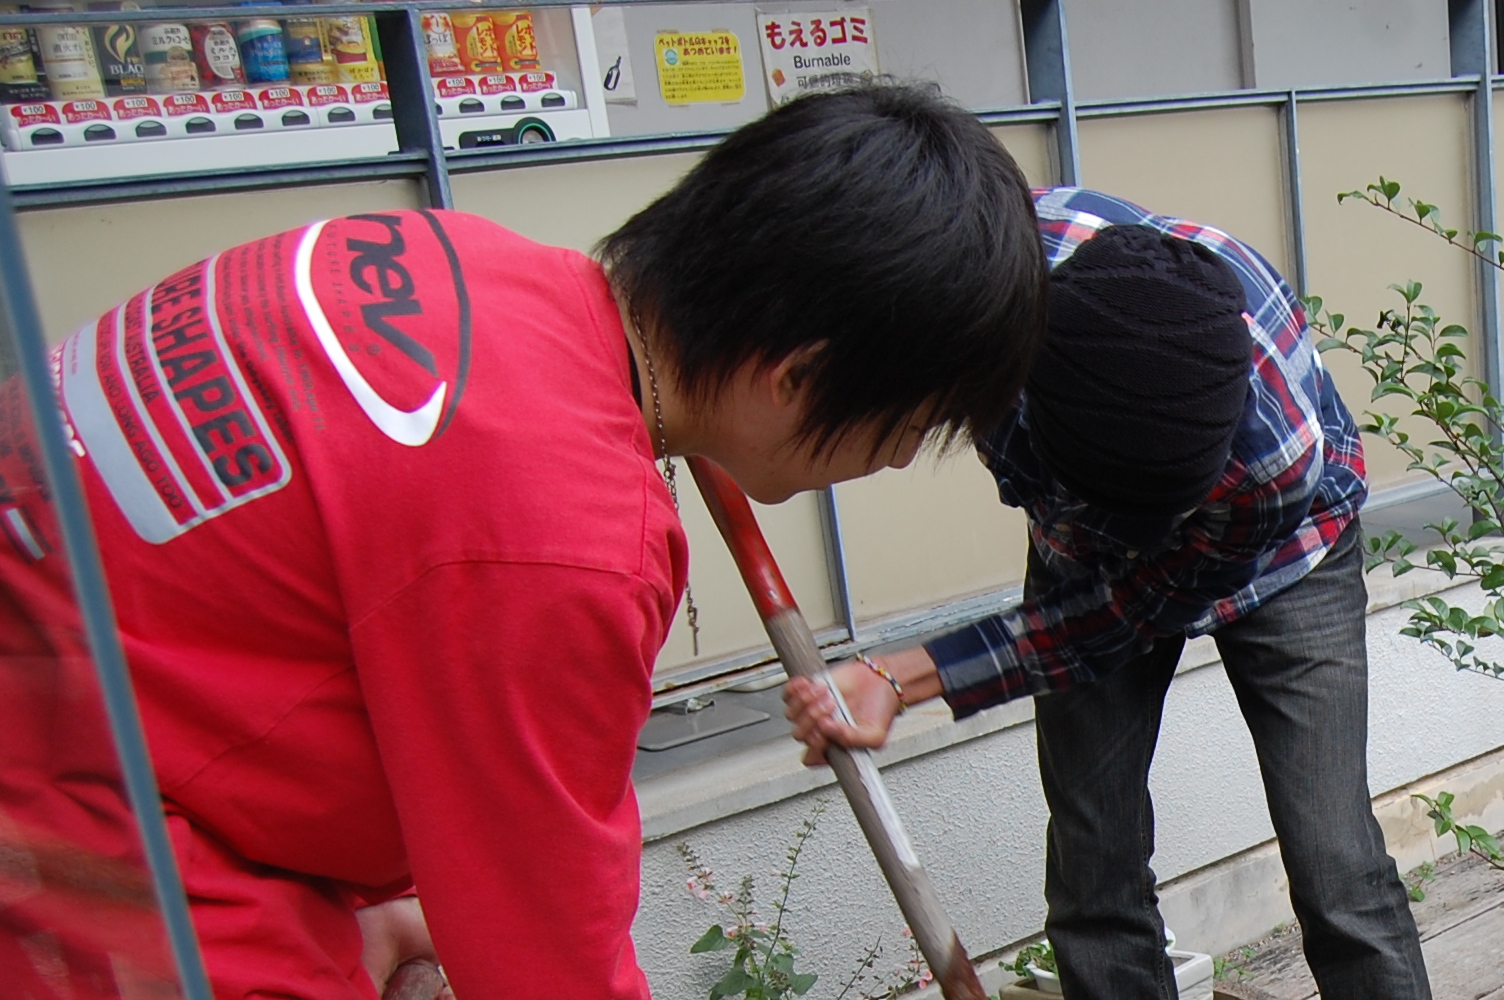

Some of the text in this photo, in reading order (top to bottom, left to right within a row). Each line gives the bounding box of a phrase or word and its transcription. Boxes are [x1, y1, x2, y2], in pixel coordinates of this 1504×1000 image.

[765, 17, 868, 50] もえるゴミ
[793, 53, 851, 69] Burnable
[346, 214, 440, 379] nev
[126, 332, 160, 404] AUSTRALIA
[152, 309, 273, 488] SHAPES
[116, 399, 138, 438] LONG
[134, 438, 159, 473] AGO
[156, 475, 184, 510] TOO
